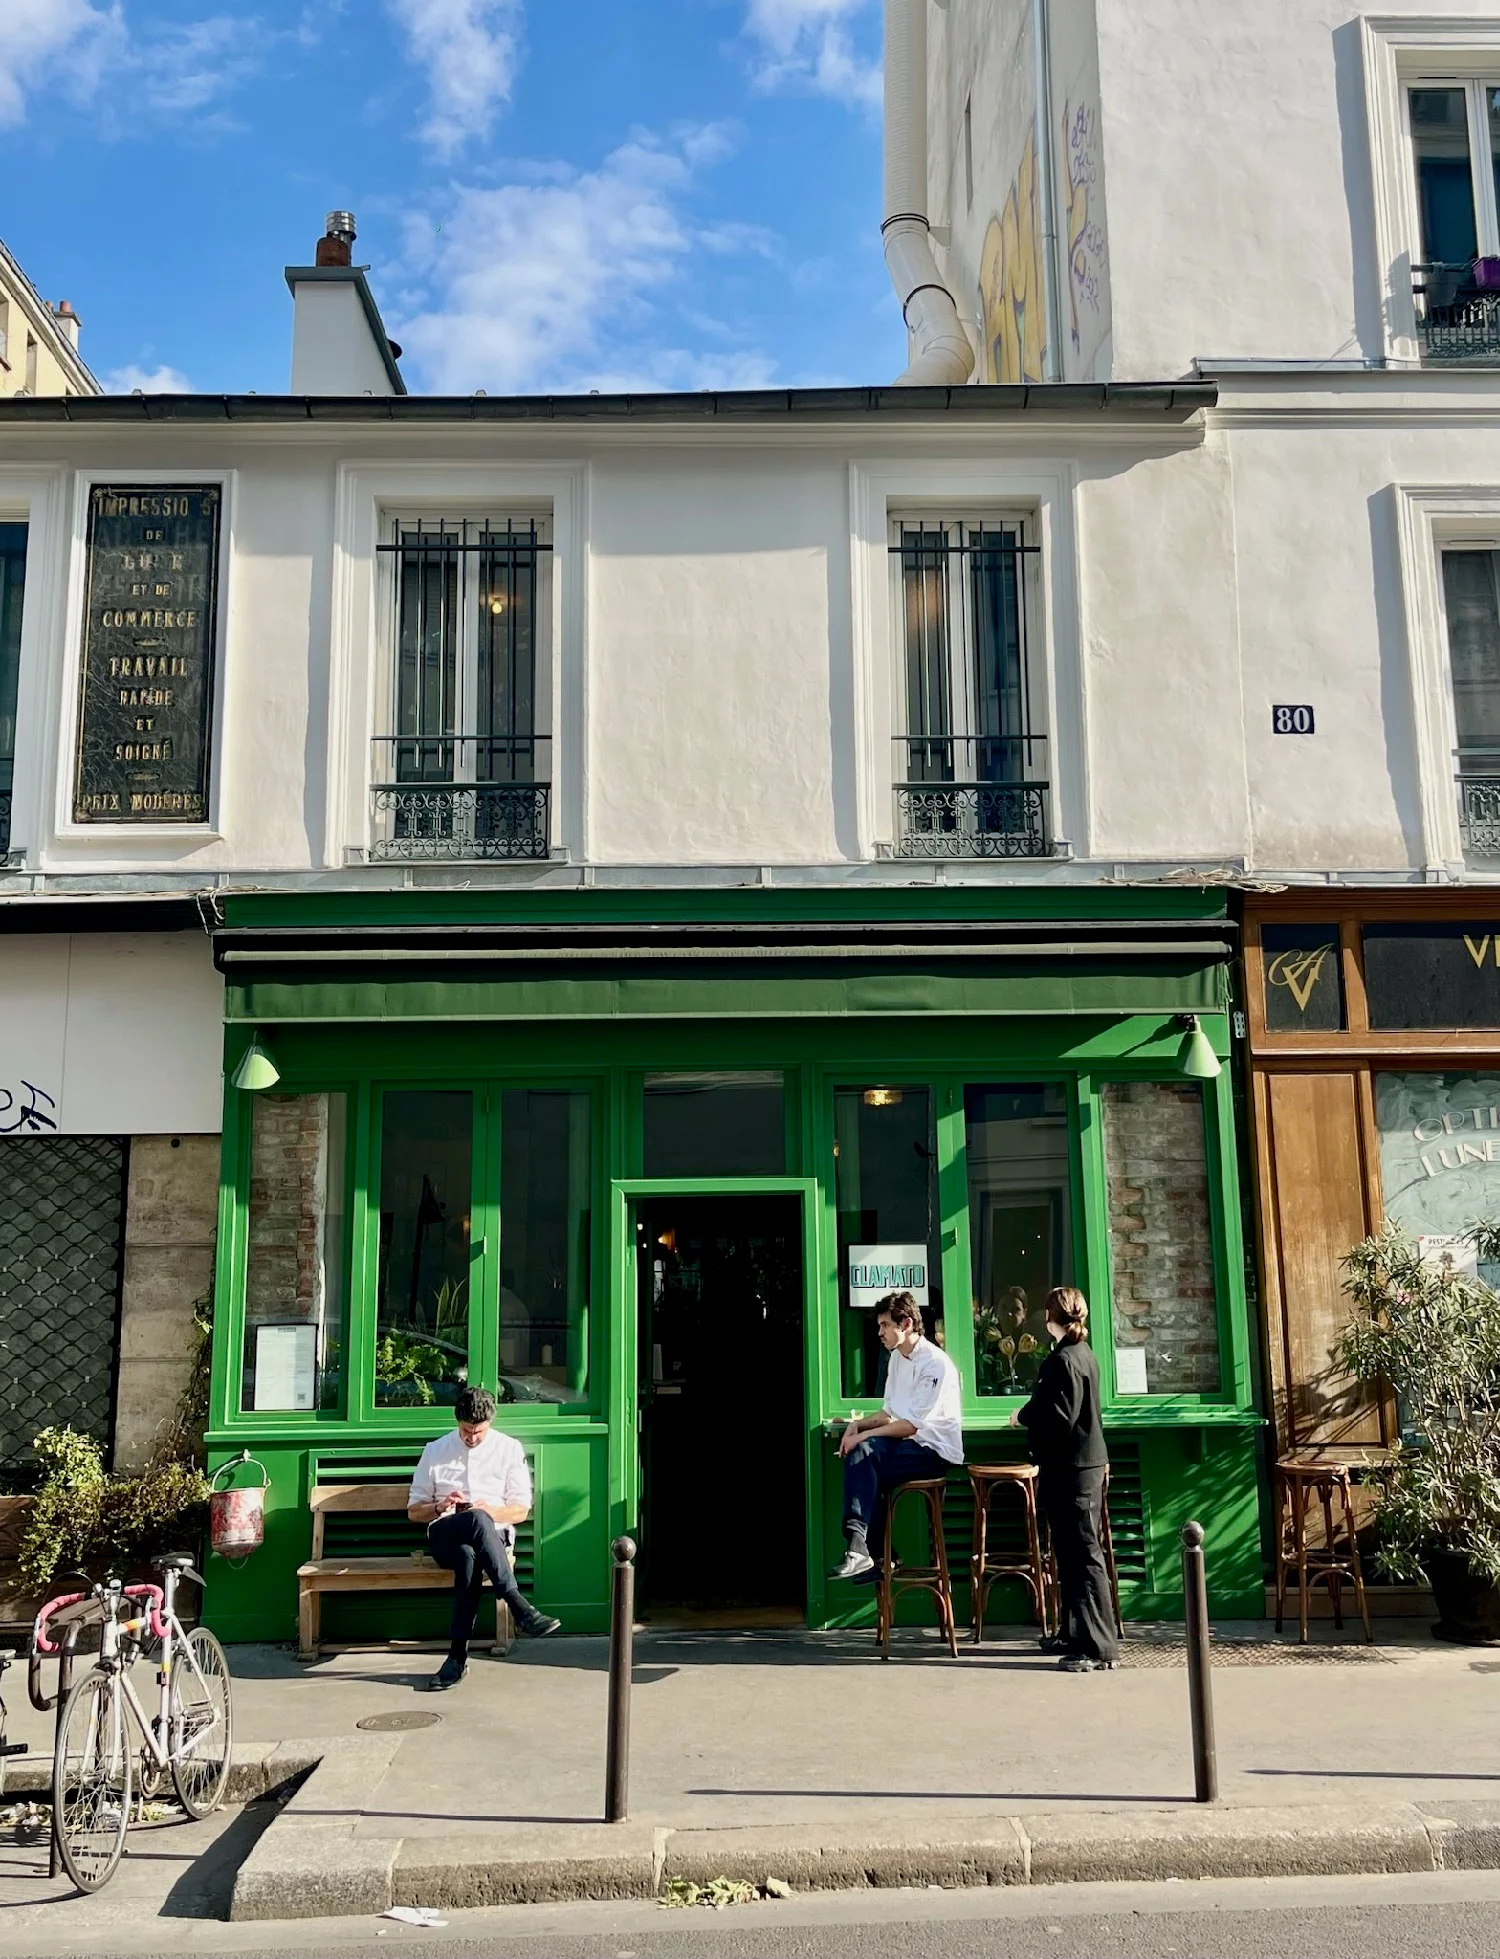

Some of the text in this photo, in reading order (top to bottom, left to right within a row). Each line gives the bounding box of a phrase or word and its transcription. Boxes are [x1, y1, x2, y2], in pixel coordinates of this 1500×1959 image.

[98, 497, 211, 517] IMPRESSIOS
[146, 530, 164, 540] DE
[132, 584, 170, 596] ET DE
[102, 611, 197, 628] COMMERCE
[110, 656, 188, 677] TRAVAIL
[136, 719, 154, 731] ET
[1277, 707, 1311, 732] 80
[116, 740, 172, 760] SOIGNÉ
[81, 793, 120, 811] PRIX
[1413, 1106, 1500, 1142] OPTI
[850, 1264, 925, 1289] CLAMATO
